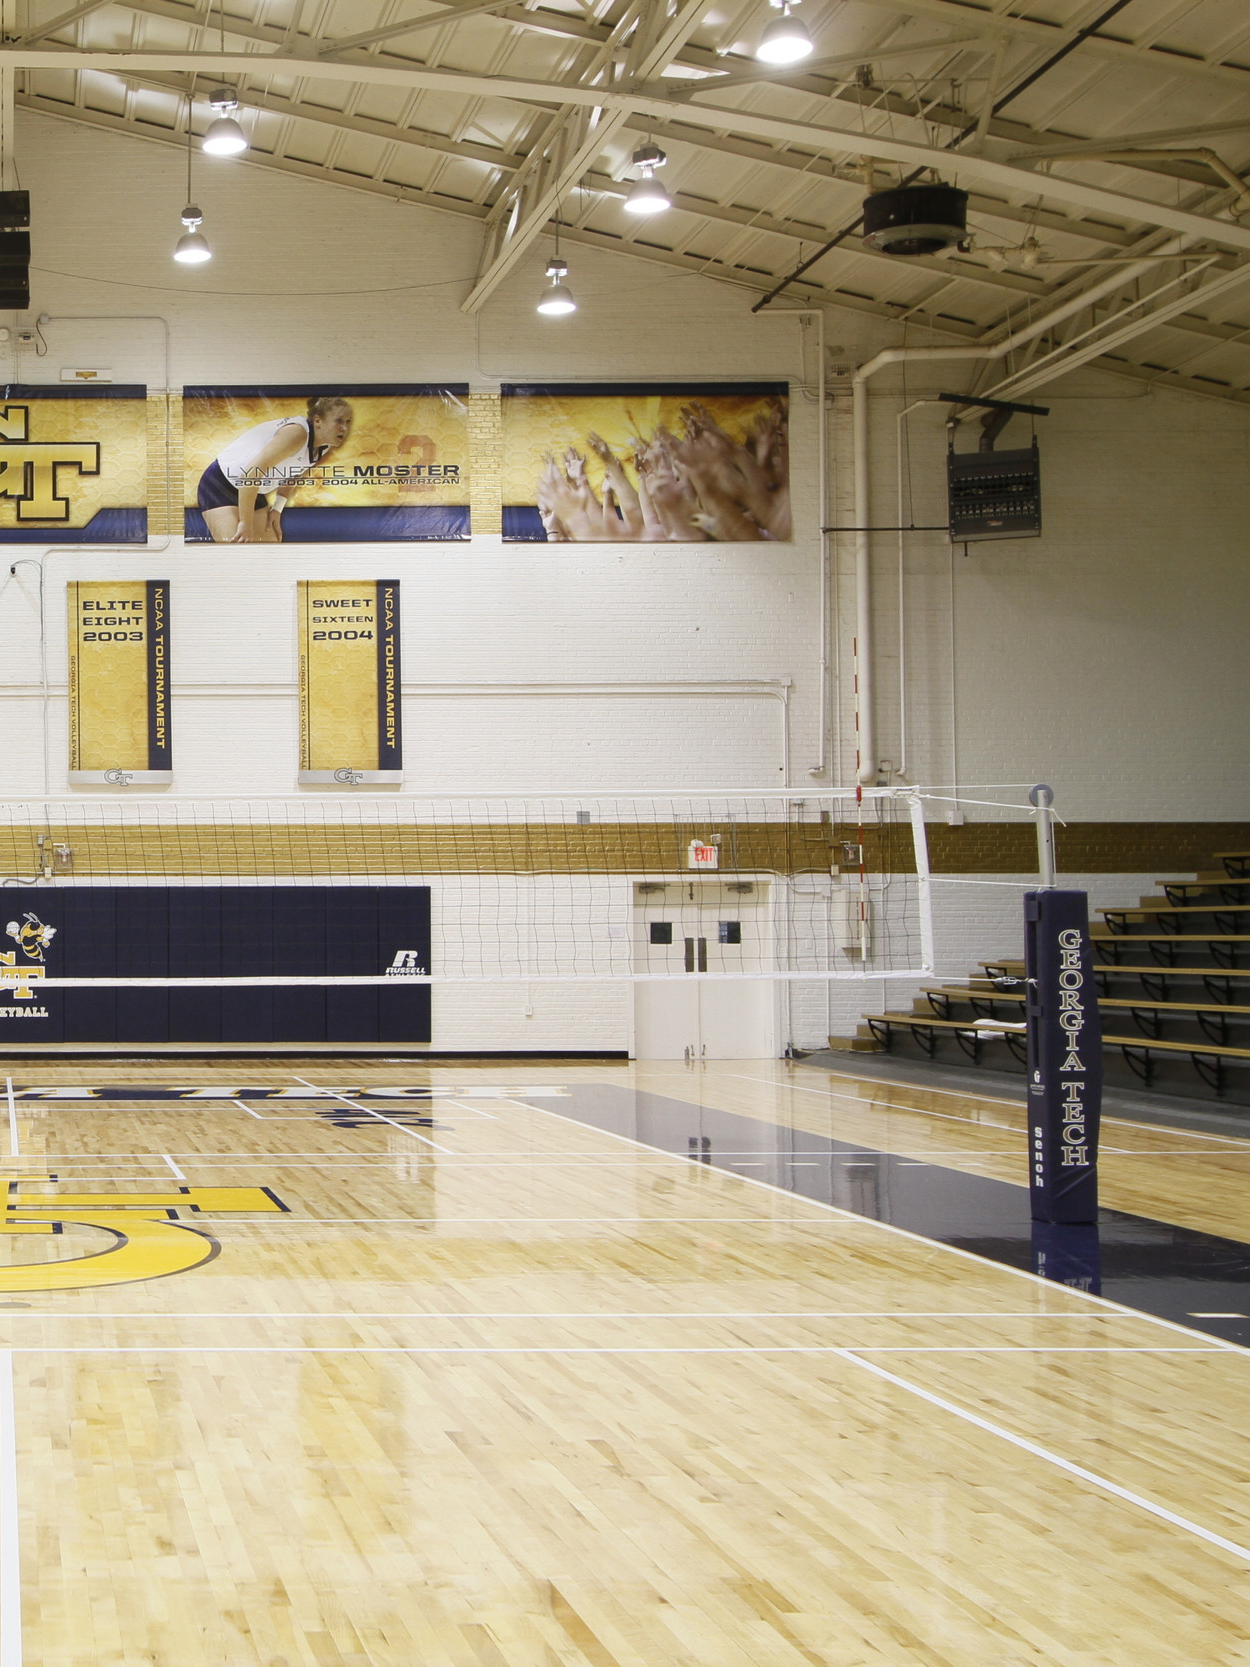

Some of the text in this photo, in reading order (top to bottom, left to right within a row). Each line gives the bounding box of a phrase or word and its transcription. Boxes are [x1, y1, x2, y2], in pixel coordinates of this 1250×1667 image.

[226, 465, 460, 478] LYNNETTE MOSTER
[83, 600, 143, 610] ELITE
[312, 600, 373, 608] SWEET
[83, 617, 143, 626] EIGHT
[83, 632, 144, 641] 2003
[313, 631, 374, 640] 2004
[155, 588, 165, 749] NCAA TOURNAMENT
[385, 588, 395, 749] NCAA TOURNAMENT
[694, 848, 714, 862] EXIT
[1058, 929, 1089, 1166] GEORGIA TECH
[1035, 1126, 1043, 1187] senoh
